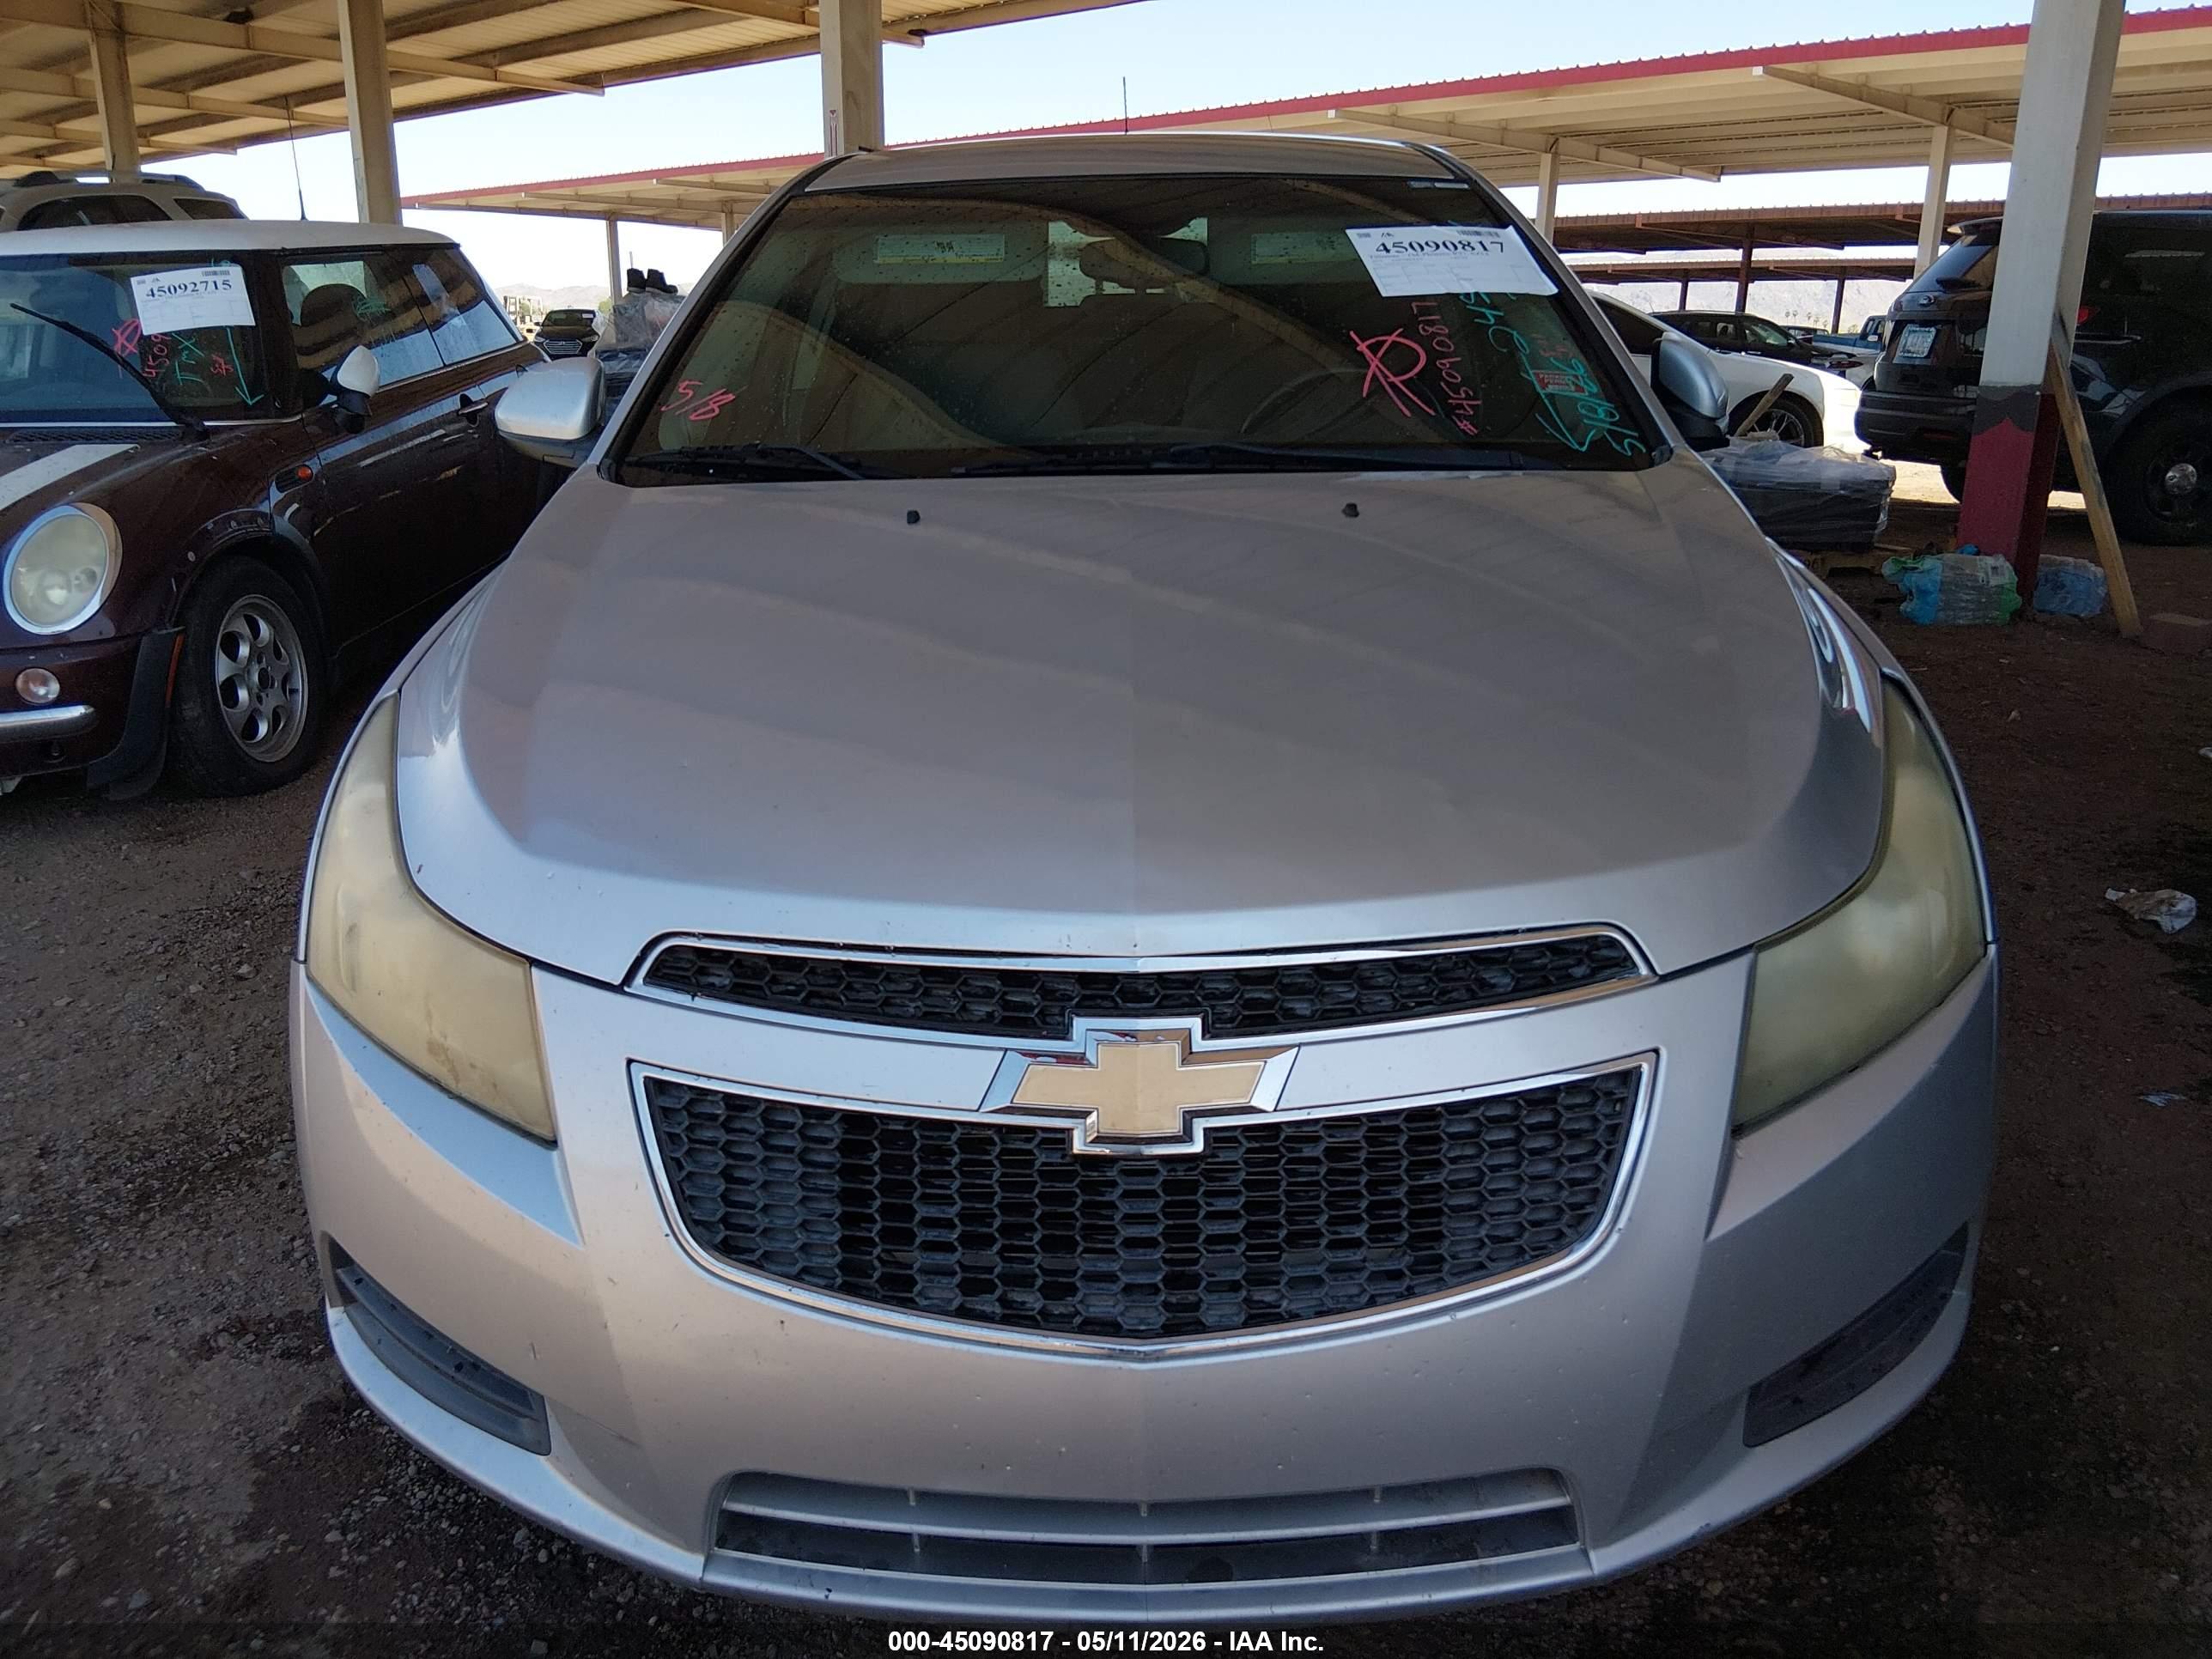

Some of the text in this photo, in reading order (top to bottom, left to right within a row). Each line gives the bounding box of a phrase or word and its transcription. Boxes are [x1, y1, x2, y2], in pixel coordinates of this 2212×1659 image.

[1375, 239, 1504, 255] 45090817
[145, 278, 233, 299] 45092715
[1411, 301, 1483, 436] #45090817
